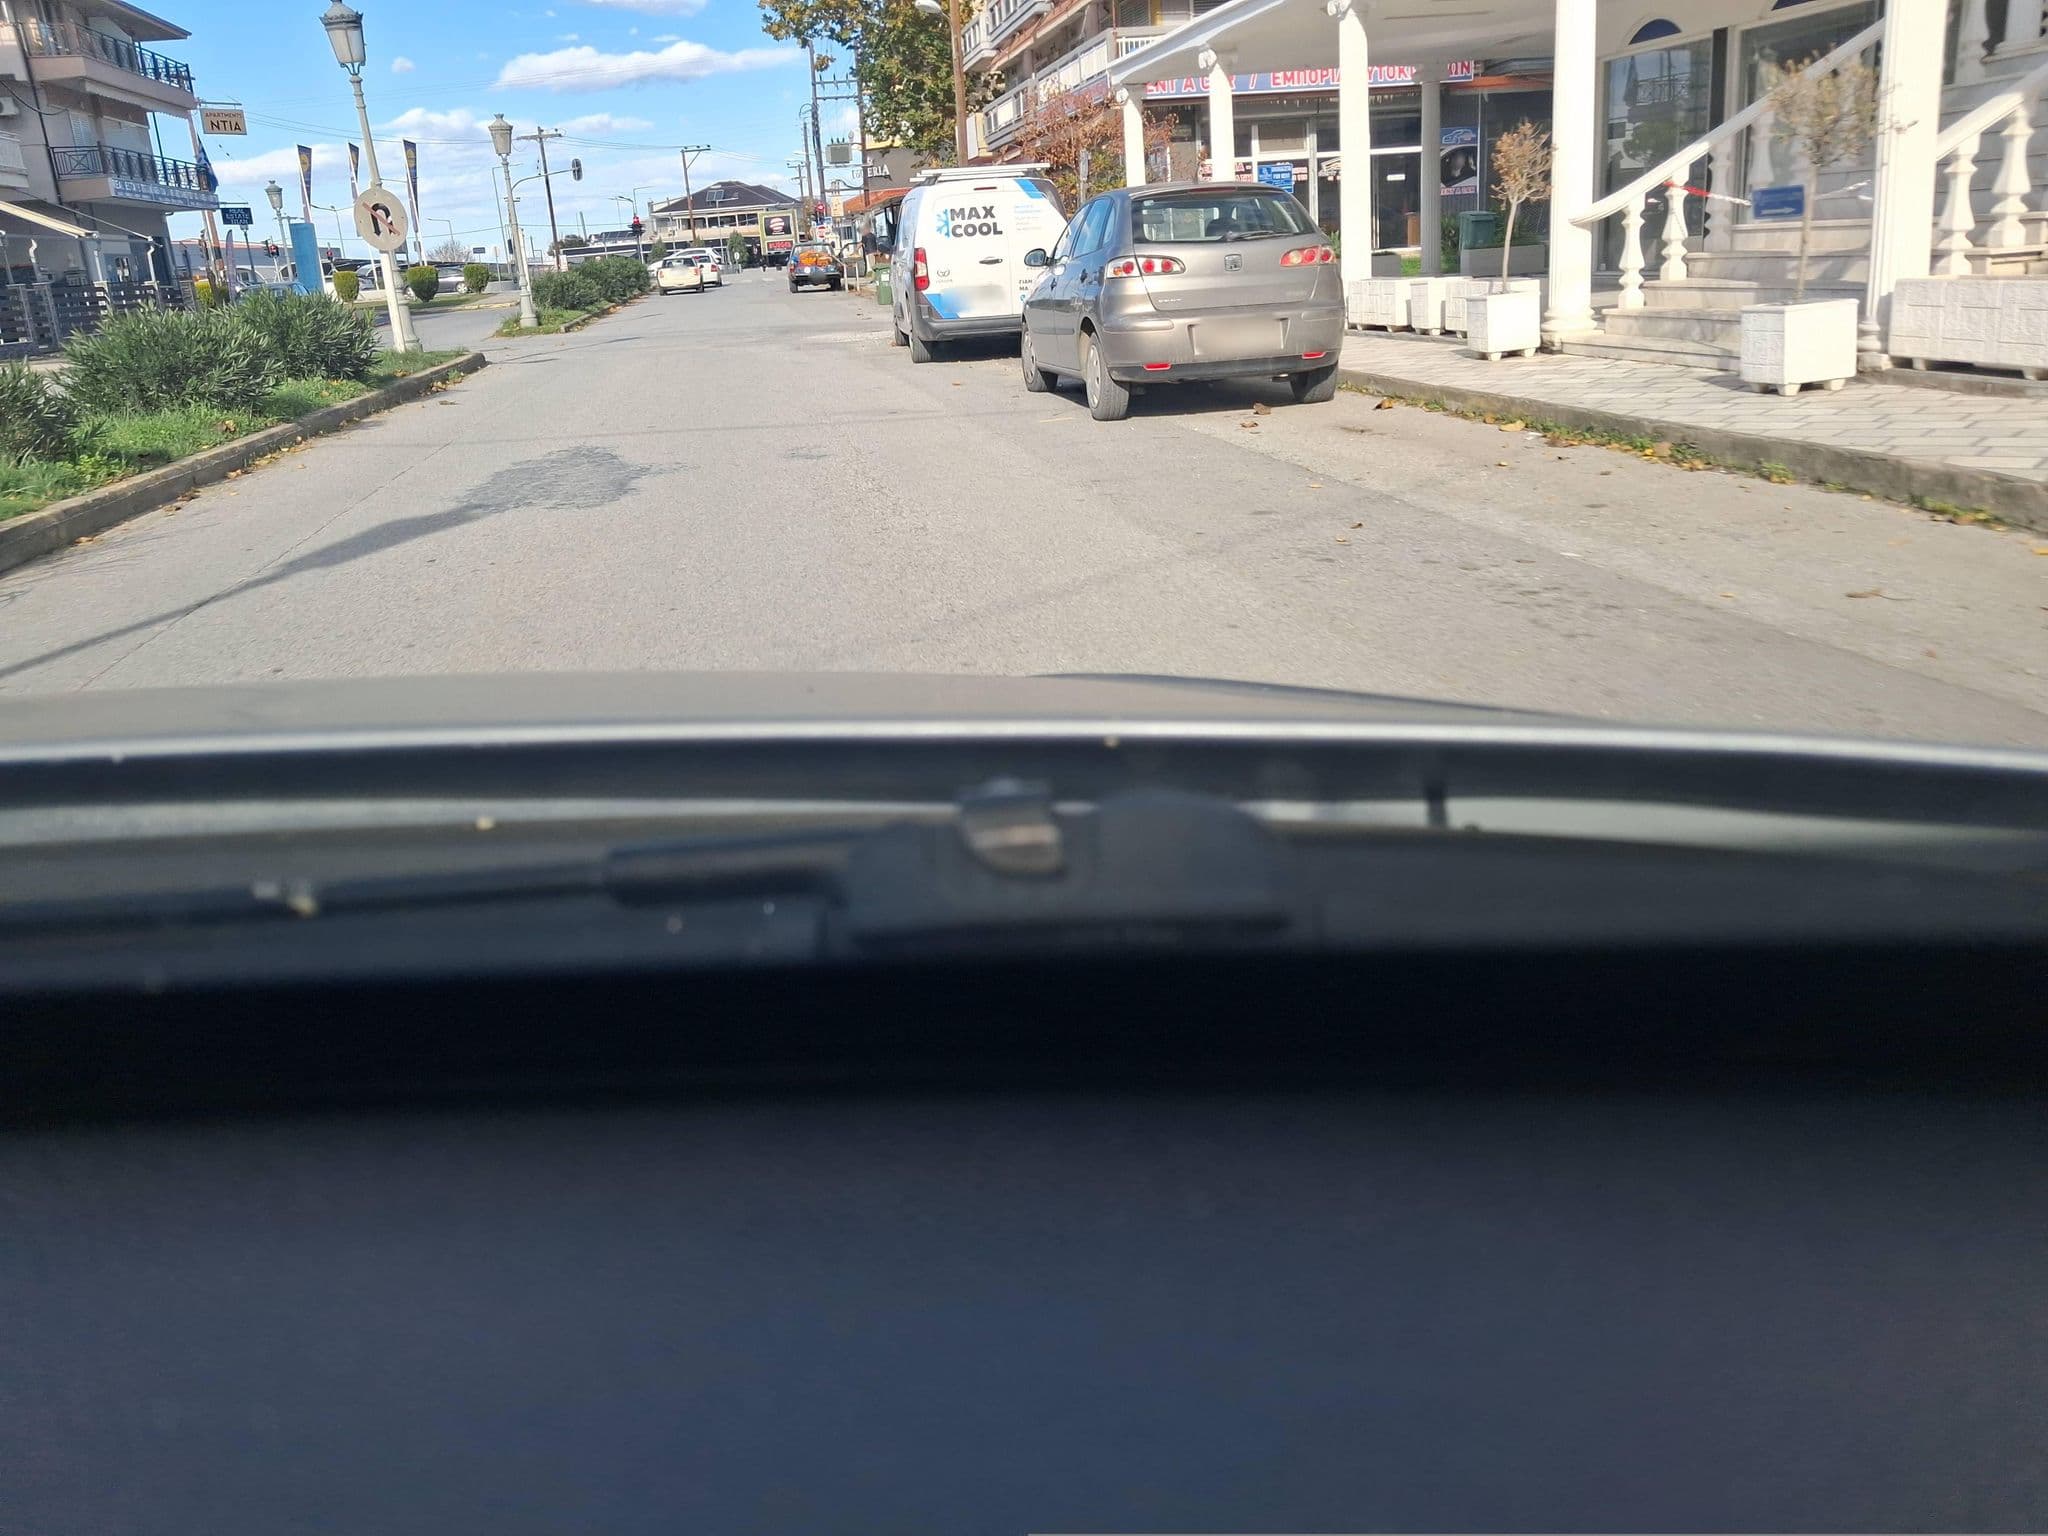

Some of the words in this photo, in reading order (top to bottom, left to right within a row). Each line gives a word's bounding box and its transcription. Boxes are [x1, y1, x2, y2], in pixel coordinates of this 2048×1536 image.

[1146, 78, 1176, 95] ENT
[1199, 74, 1236, 91] CR
[210, 119, 242, 132] NTIA
[950, 206, 996, 221] MAX
[951, 222, 1003, 238] COOL
